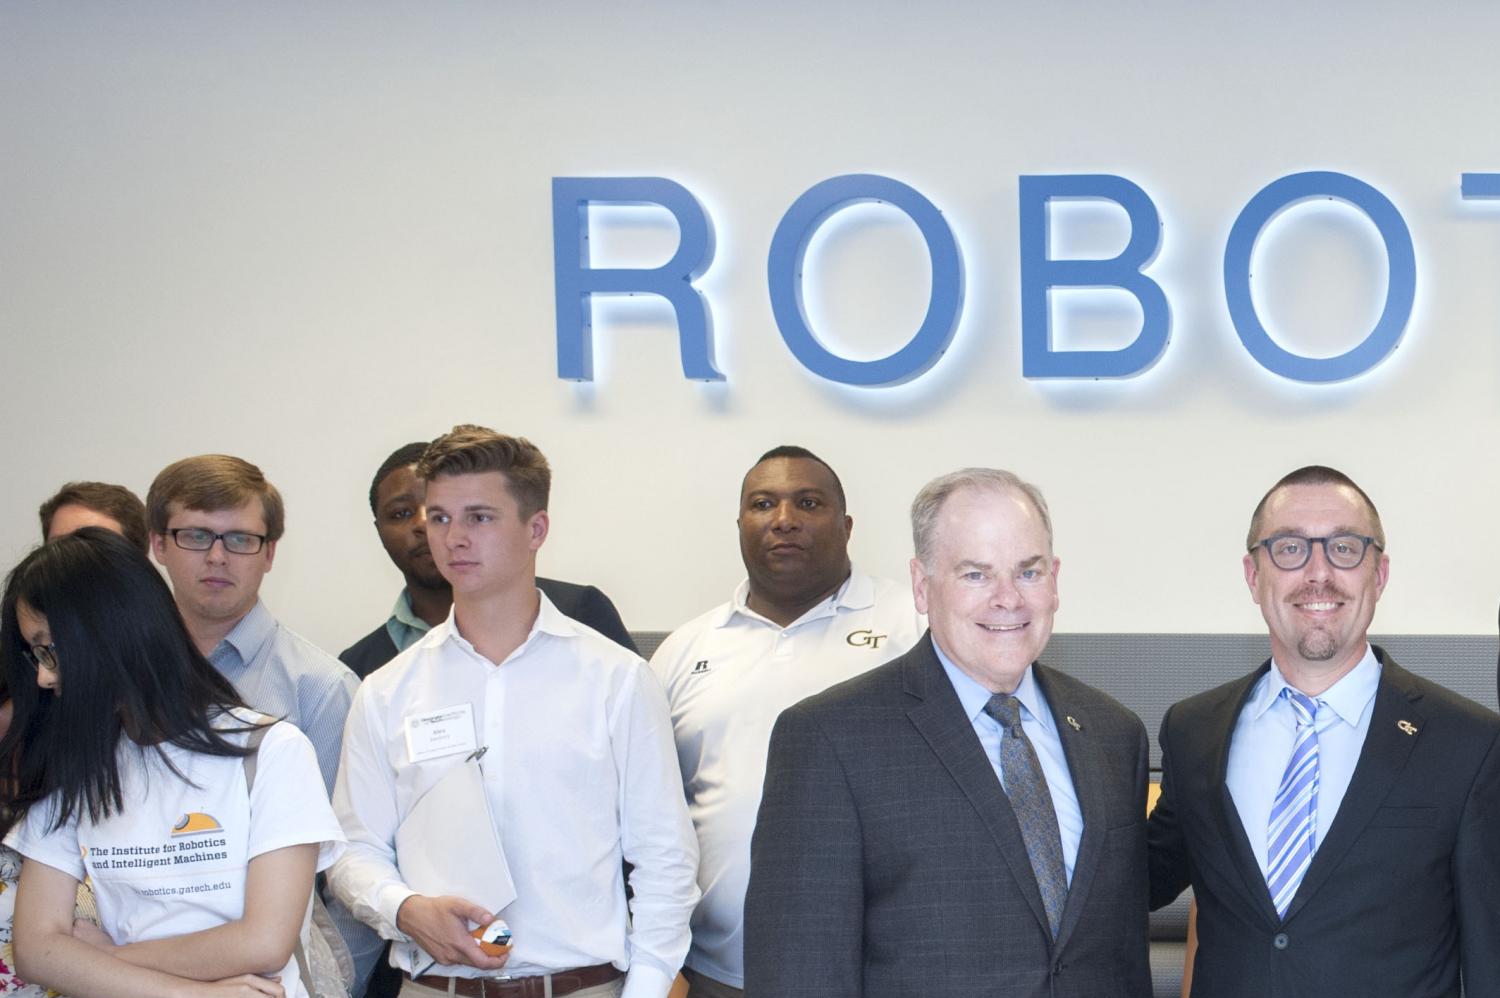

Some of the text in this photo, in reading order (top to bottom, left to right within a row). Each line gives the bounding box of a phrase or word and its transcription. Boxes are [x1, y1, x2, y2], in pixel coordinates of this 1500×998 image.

[90, 838, 227, 856] The Institute for Robotics
[91, 850, 228, 870] and Intelligent Machines
